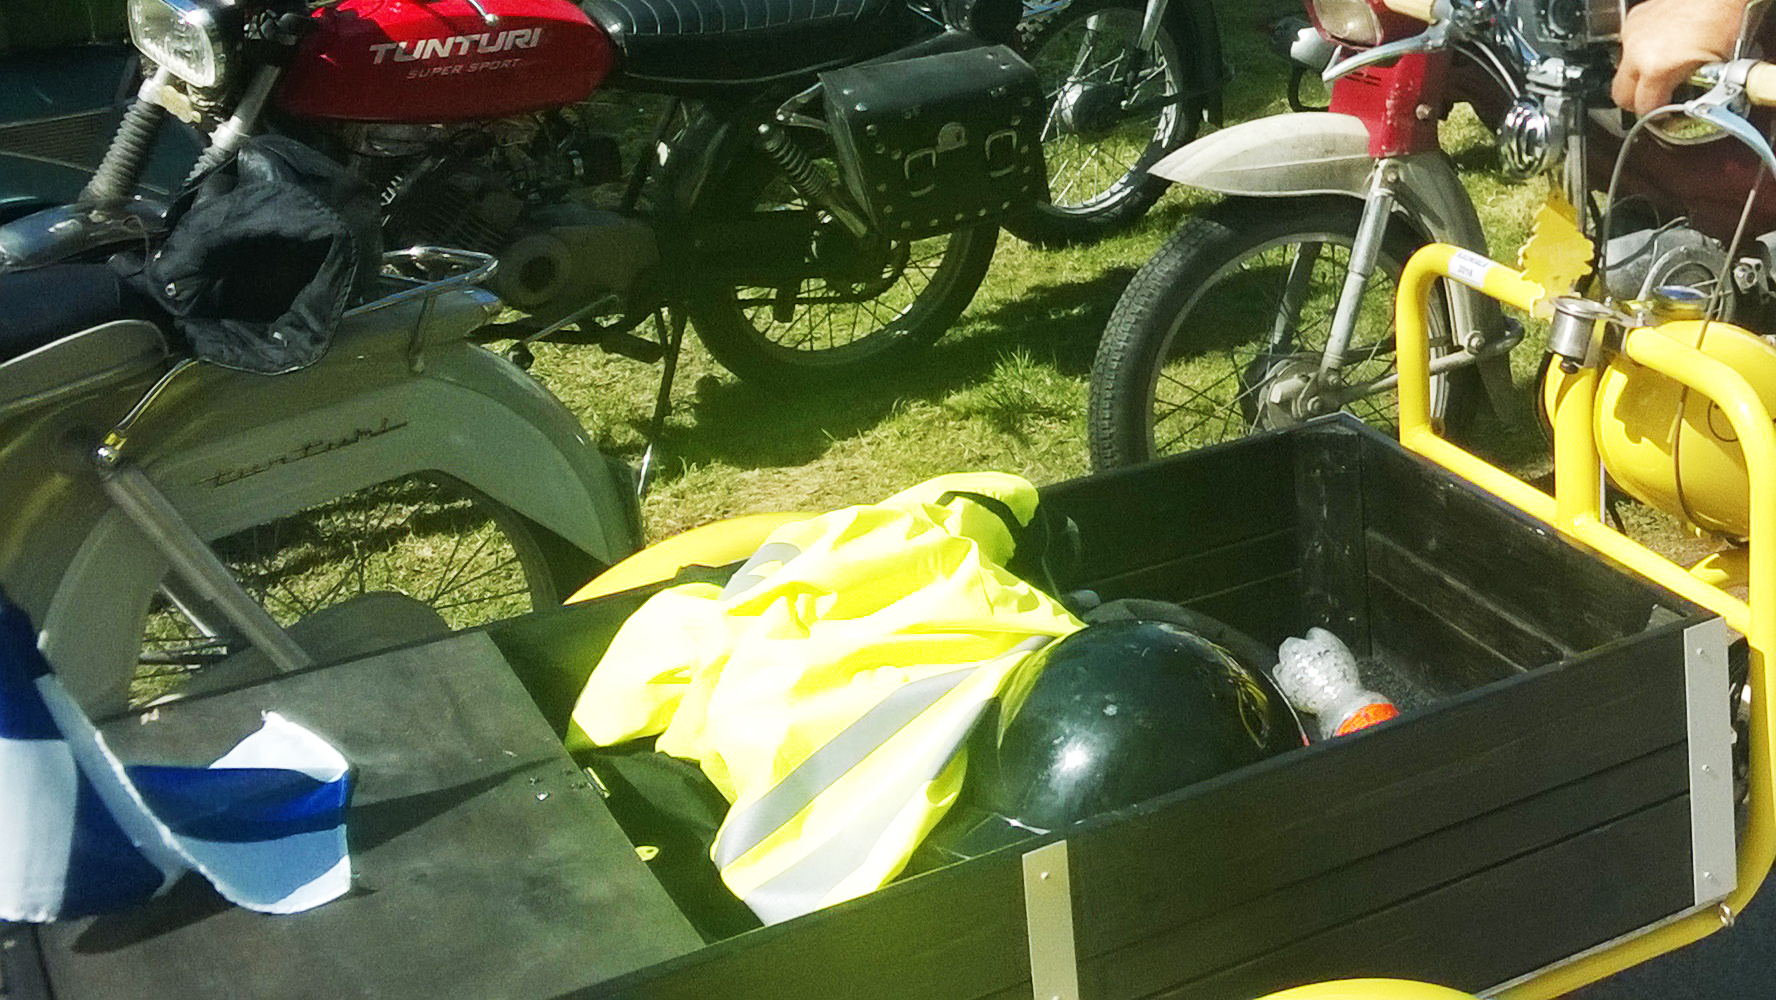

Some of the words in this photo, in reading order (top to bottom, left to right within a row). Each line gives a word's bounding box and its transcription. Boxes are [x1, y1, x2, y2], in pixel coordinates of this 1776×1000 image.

[369, 28, 542, 64] TUNTURI
[406, 63, 463, 80] SUPER
[466, 57, 522, 74] SPORT
